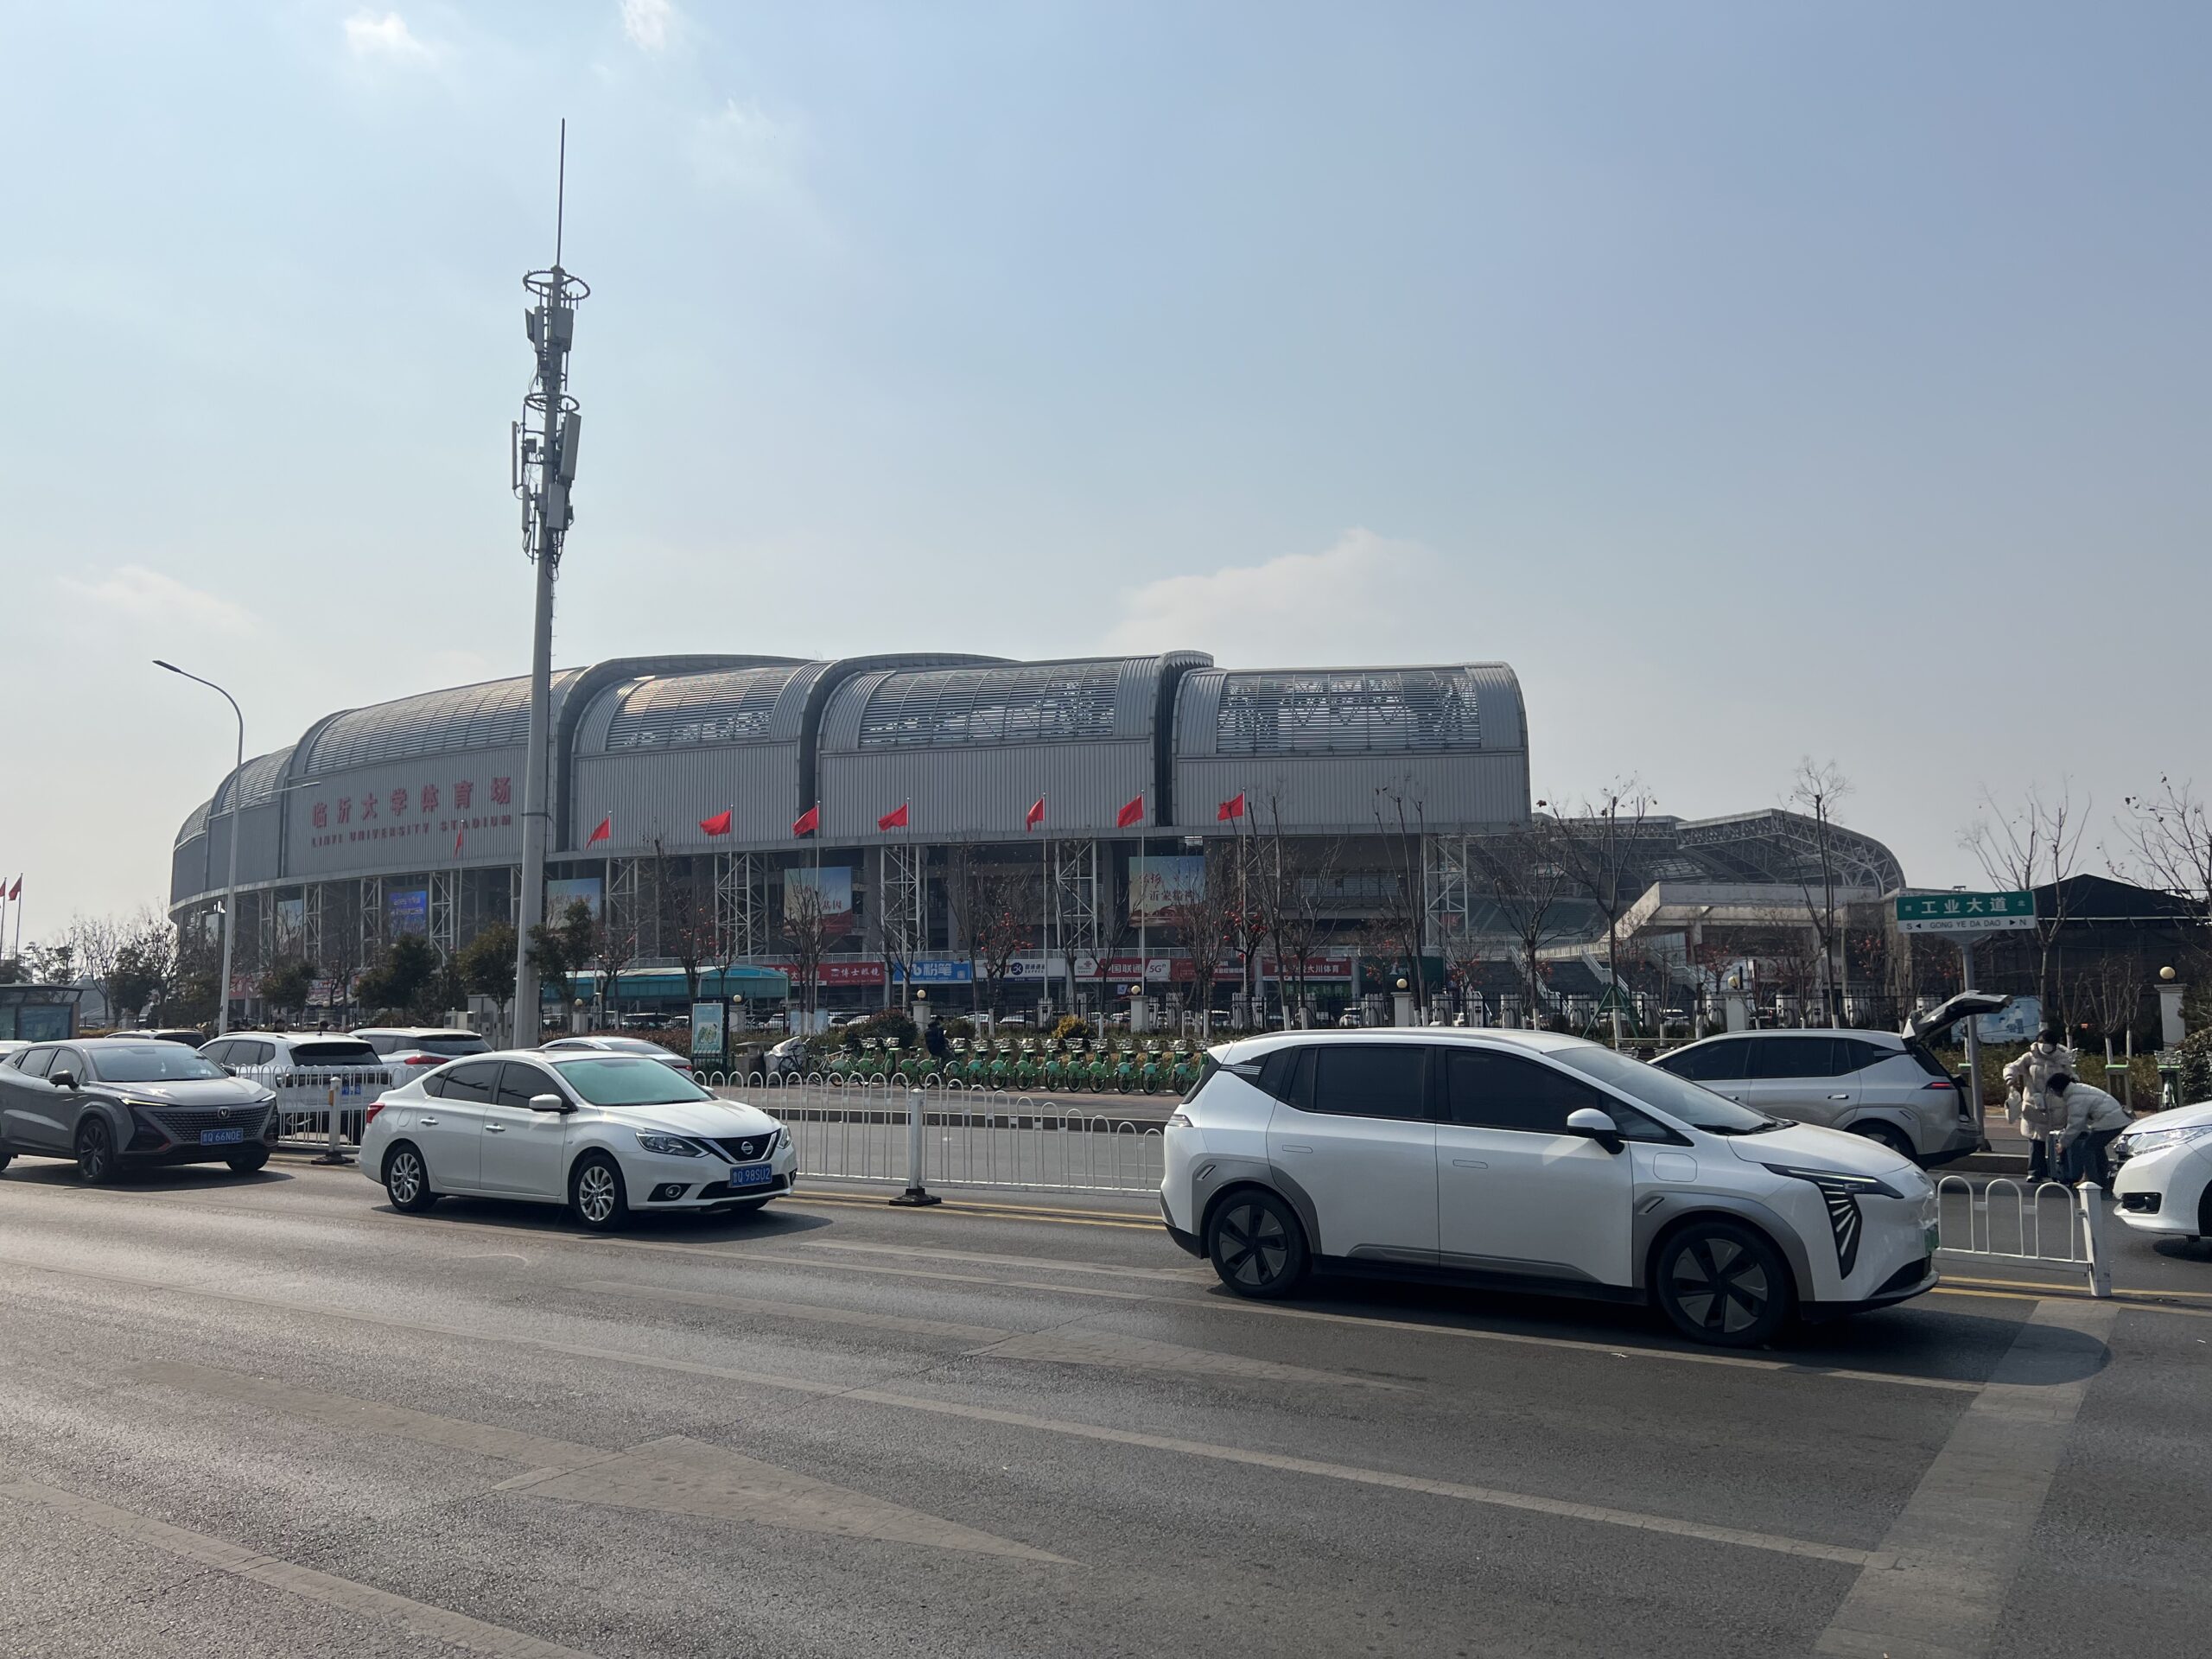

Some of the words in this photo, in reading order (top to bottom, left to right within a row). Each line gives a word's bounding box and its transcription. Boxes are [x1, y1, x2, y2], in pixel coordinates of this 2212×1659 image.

[312, 777, 511, 829] 临沂大学体育场
[349, 823, 429, 842] UNIVERSITY
[441, 815, 512, 832] STADIUM
[1921, 896, 2008, 914] 工业大道
[841, 967, 880, 977] 博士眼镜
[923, 963, 952, 976] 粉笔
